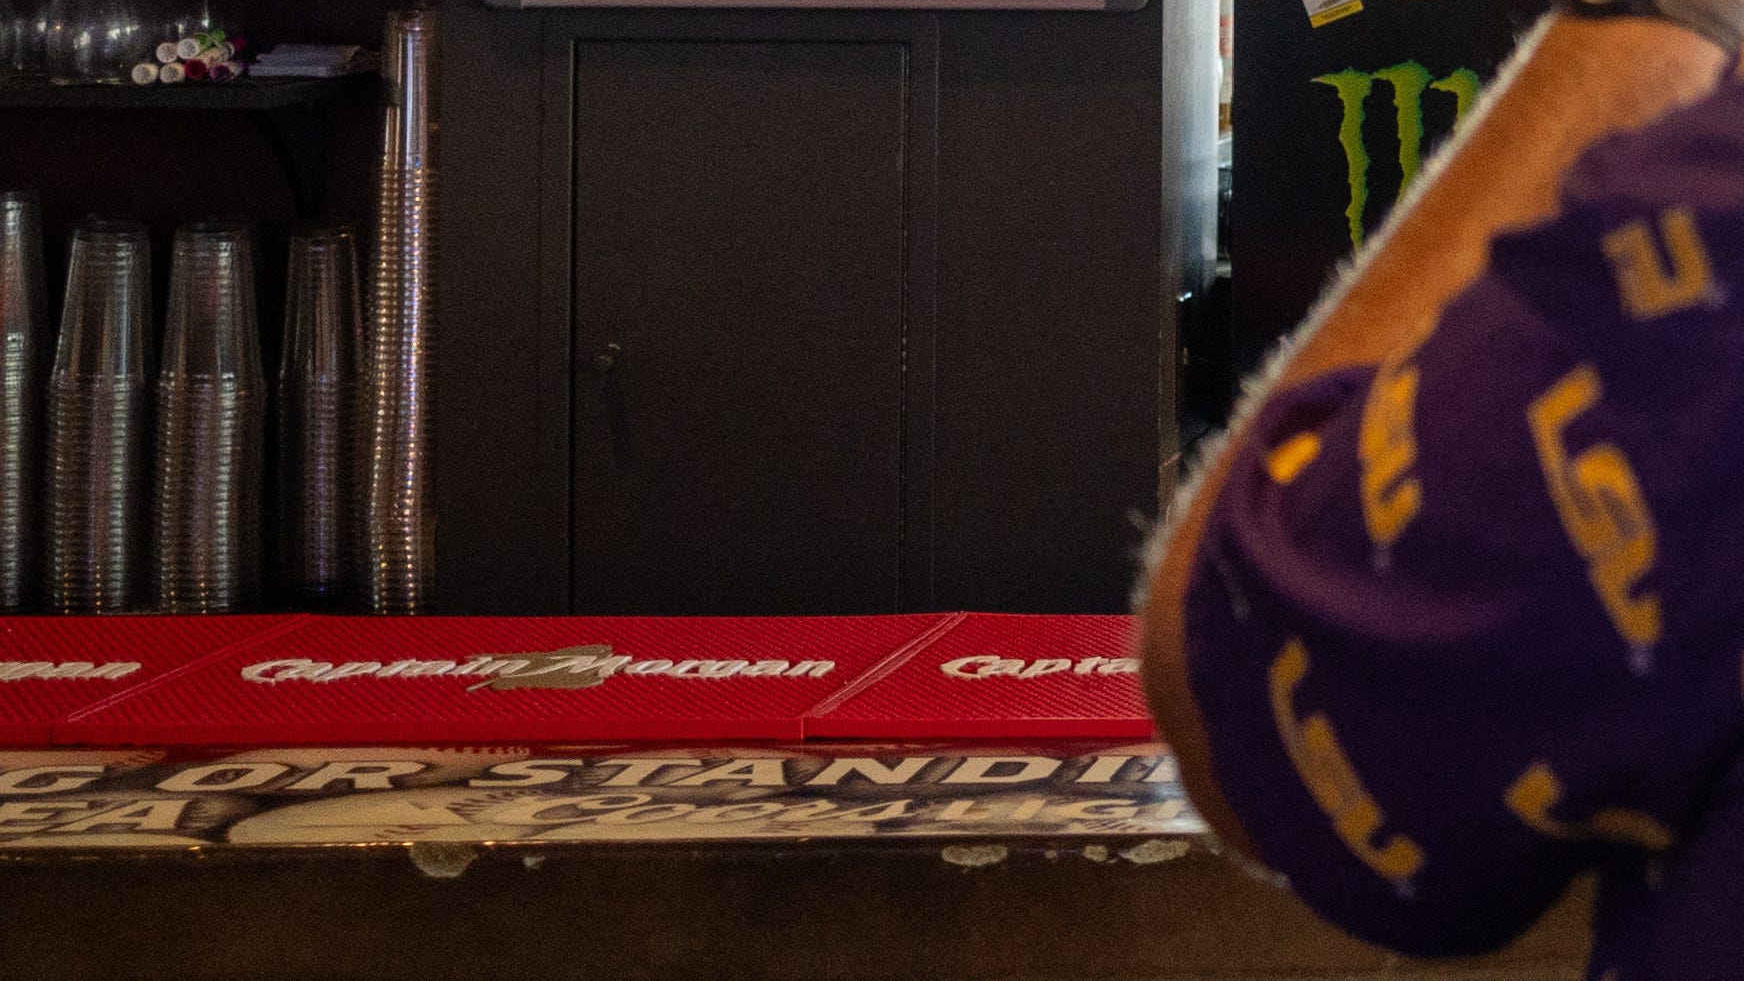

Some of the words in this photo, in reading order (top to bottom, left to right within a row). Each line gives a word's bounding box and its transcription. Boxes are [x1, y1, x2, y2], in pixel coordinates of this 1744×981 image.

[240, 656, 530, 685] Captain
[500, 655, 836, 683] Morgan
[155, 760, 428, 793] OR
[490, 793, 924, 827] Coors
